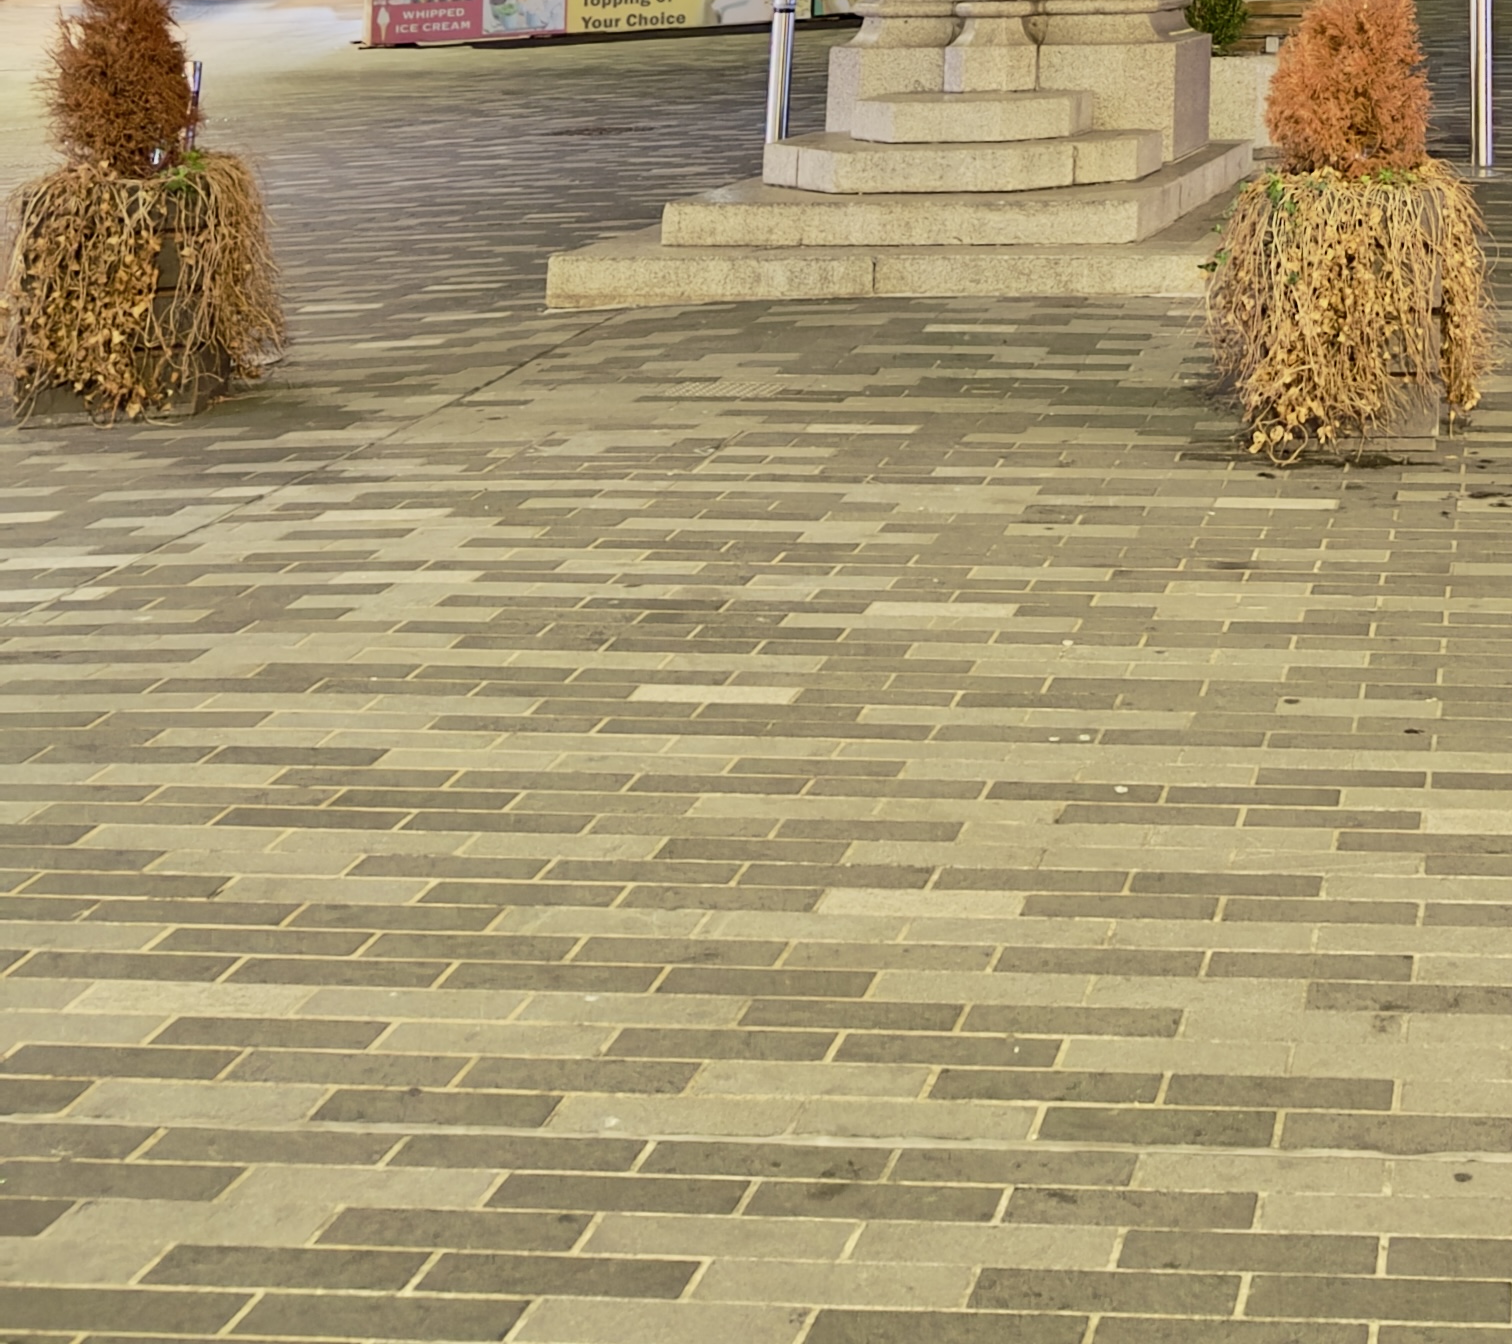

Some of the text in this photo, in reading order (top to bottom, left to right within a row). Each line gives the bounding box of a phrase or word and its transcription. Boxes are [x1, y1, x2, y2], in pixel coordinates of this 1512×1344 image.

[402, 7, 466, 20] WHIPPED
[395, 20, 471, 34] ICE CREAM
[581, 12, 686, 30] Your Choice
